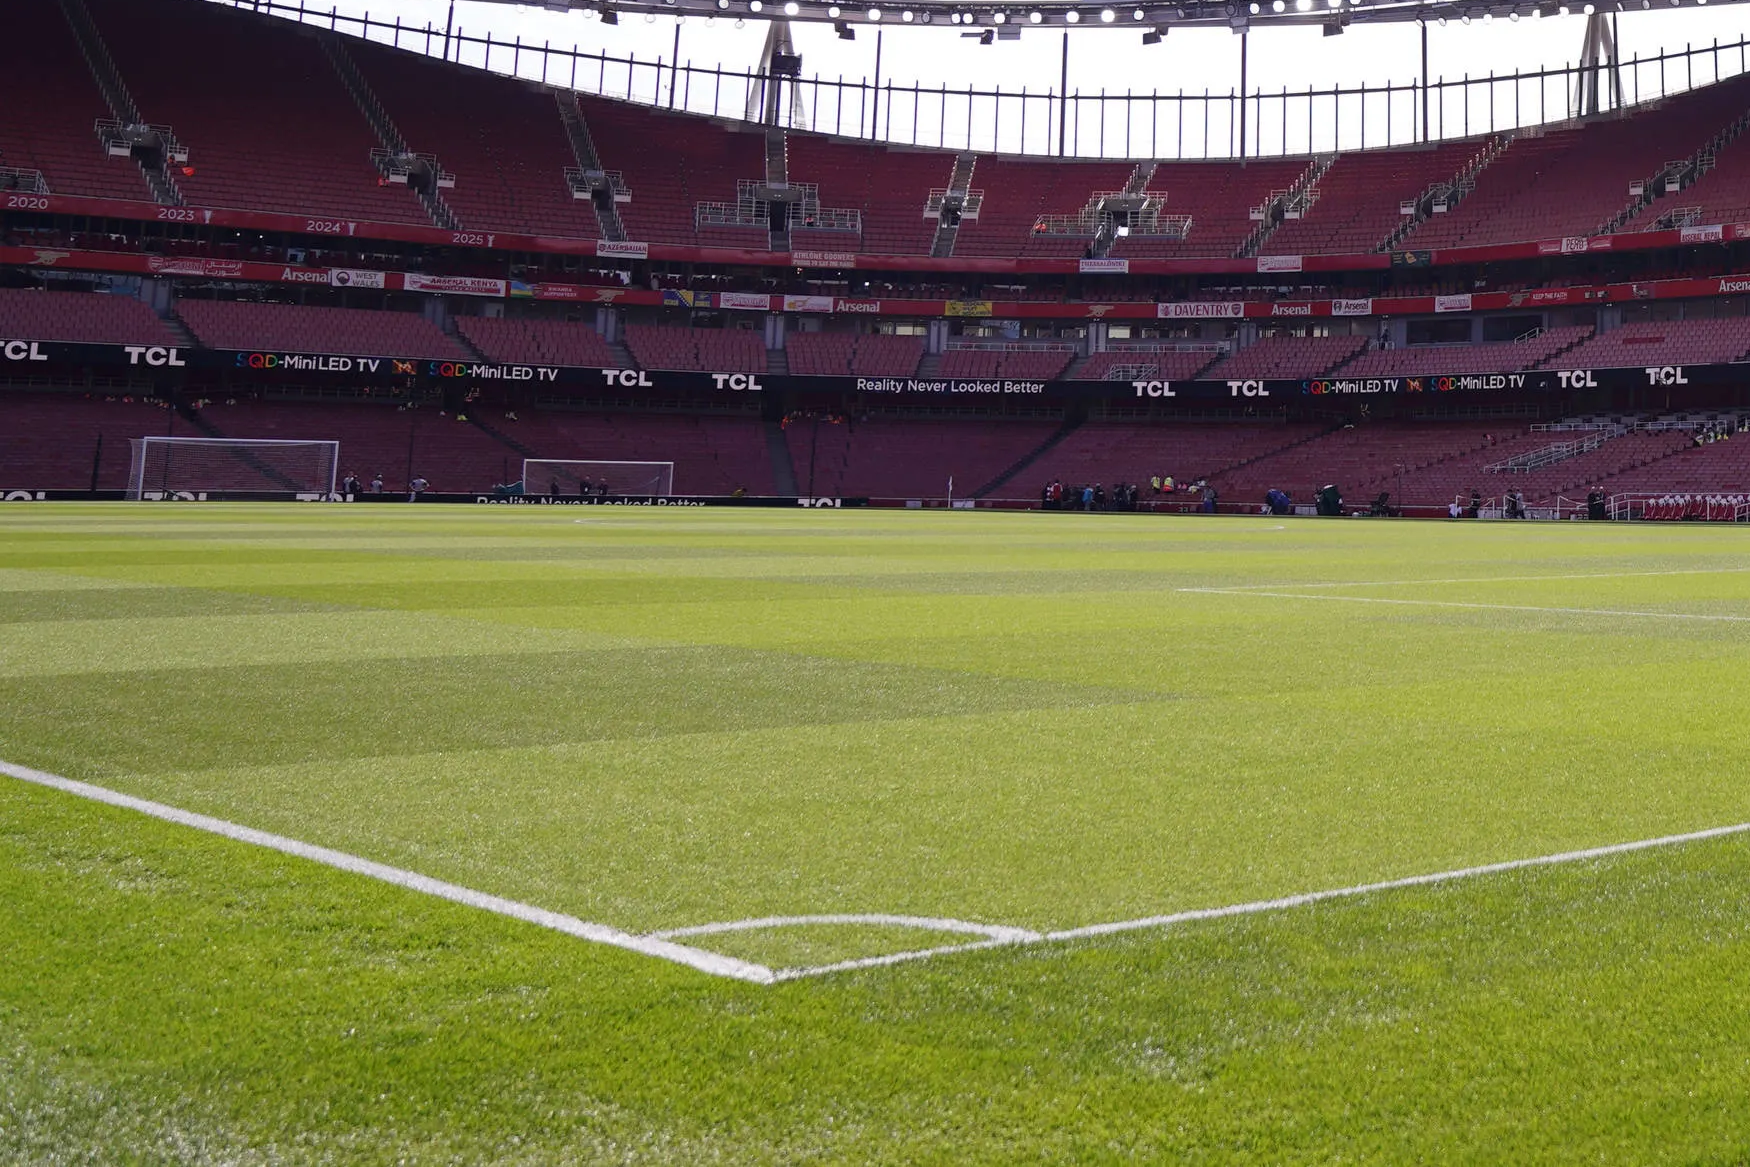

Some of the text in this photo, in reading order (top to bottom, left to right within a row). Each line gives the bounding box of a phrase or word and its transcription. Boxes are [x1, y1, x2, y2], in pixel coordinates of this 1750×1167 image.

[7, 196, 49, 210] 2020
[158, 208, 195, 221] 2023
[306, 220, 341, 233] 2024
[453, 233, 484, 245] 2025
[281, 267, 331, 283] Arsenal
[430, 277, 498, 288] ARSENAL KENYA
[836, 300, 880, 312] Arsenal
[1174, 304, 1230, 316] DAVENTRY
[1271, 304, 1311, 315] Arsenal
[0, 341, 48, 361] CL
[124, 346, 185, 367] TCL
[356, 358, 380, 373] TV
[538, 369, 558, 381] TV
[602, 369, 652, 387] TCL
[712, 373, 762, 390] TCL
[1510, 375, 1525, 388] TV
[1557, 370, 1597, 388] TCL
[1646, 366, 1688, 385] TCL
[857, 378, 1044, 394] Reality Never Looked Better
[1132, 381, 1176, 397] TCL
[1227, 380, 1270, 397] TCL
[1385, 378, 1399, 392] TV
